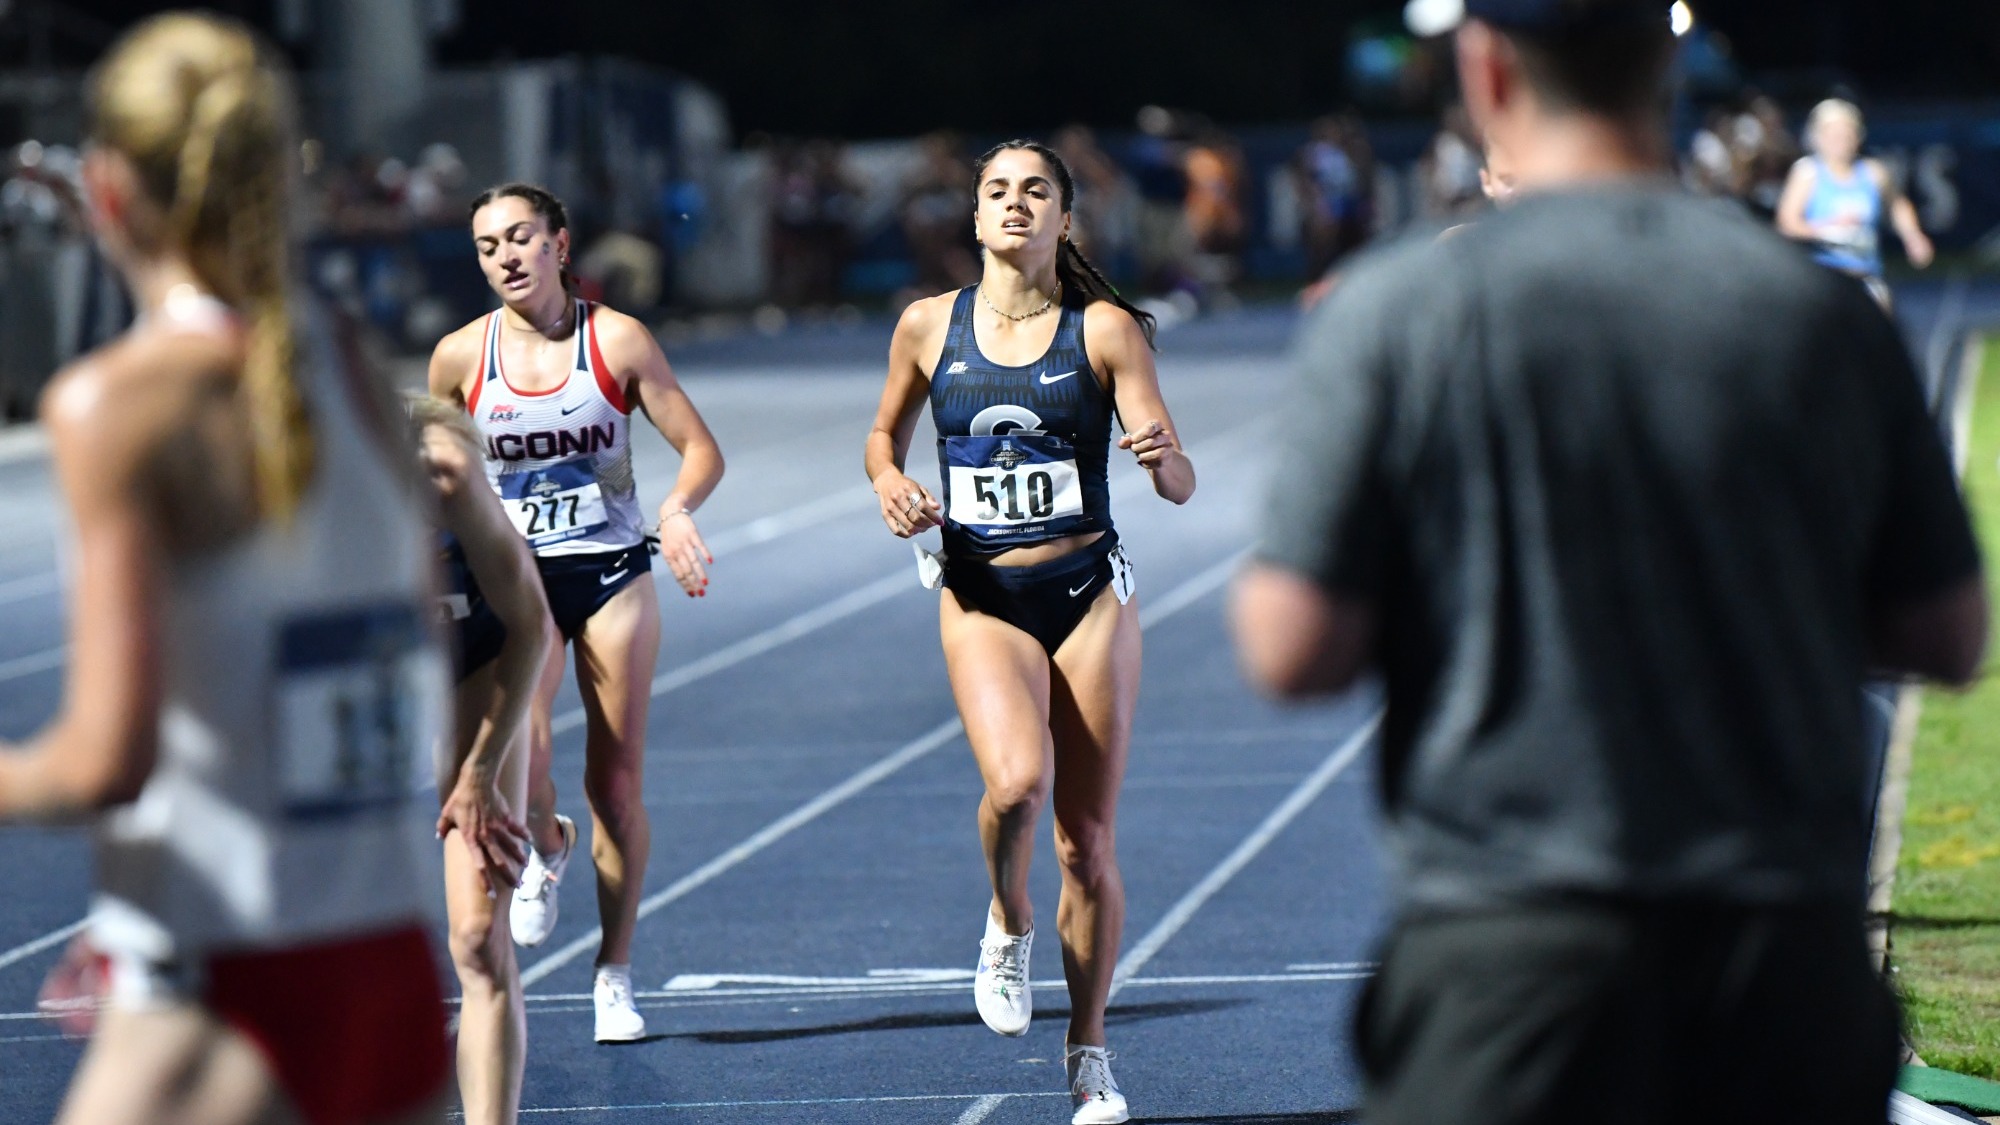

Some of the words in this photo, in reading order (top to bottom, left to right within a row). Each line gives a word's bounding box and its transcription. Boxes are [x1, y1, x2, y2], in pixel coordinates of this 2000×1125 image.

[488, 411, 522, 421] EAST
[973, 471, 1054, 521] 510
[521, 494, 580, 535] 277
[1024, 525, 1045, 533] FLORIDA
